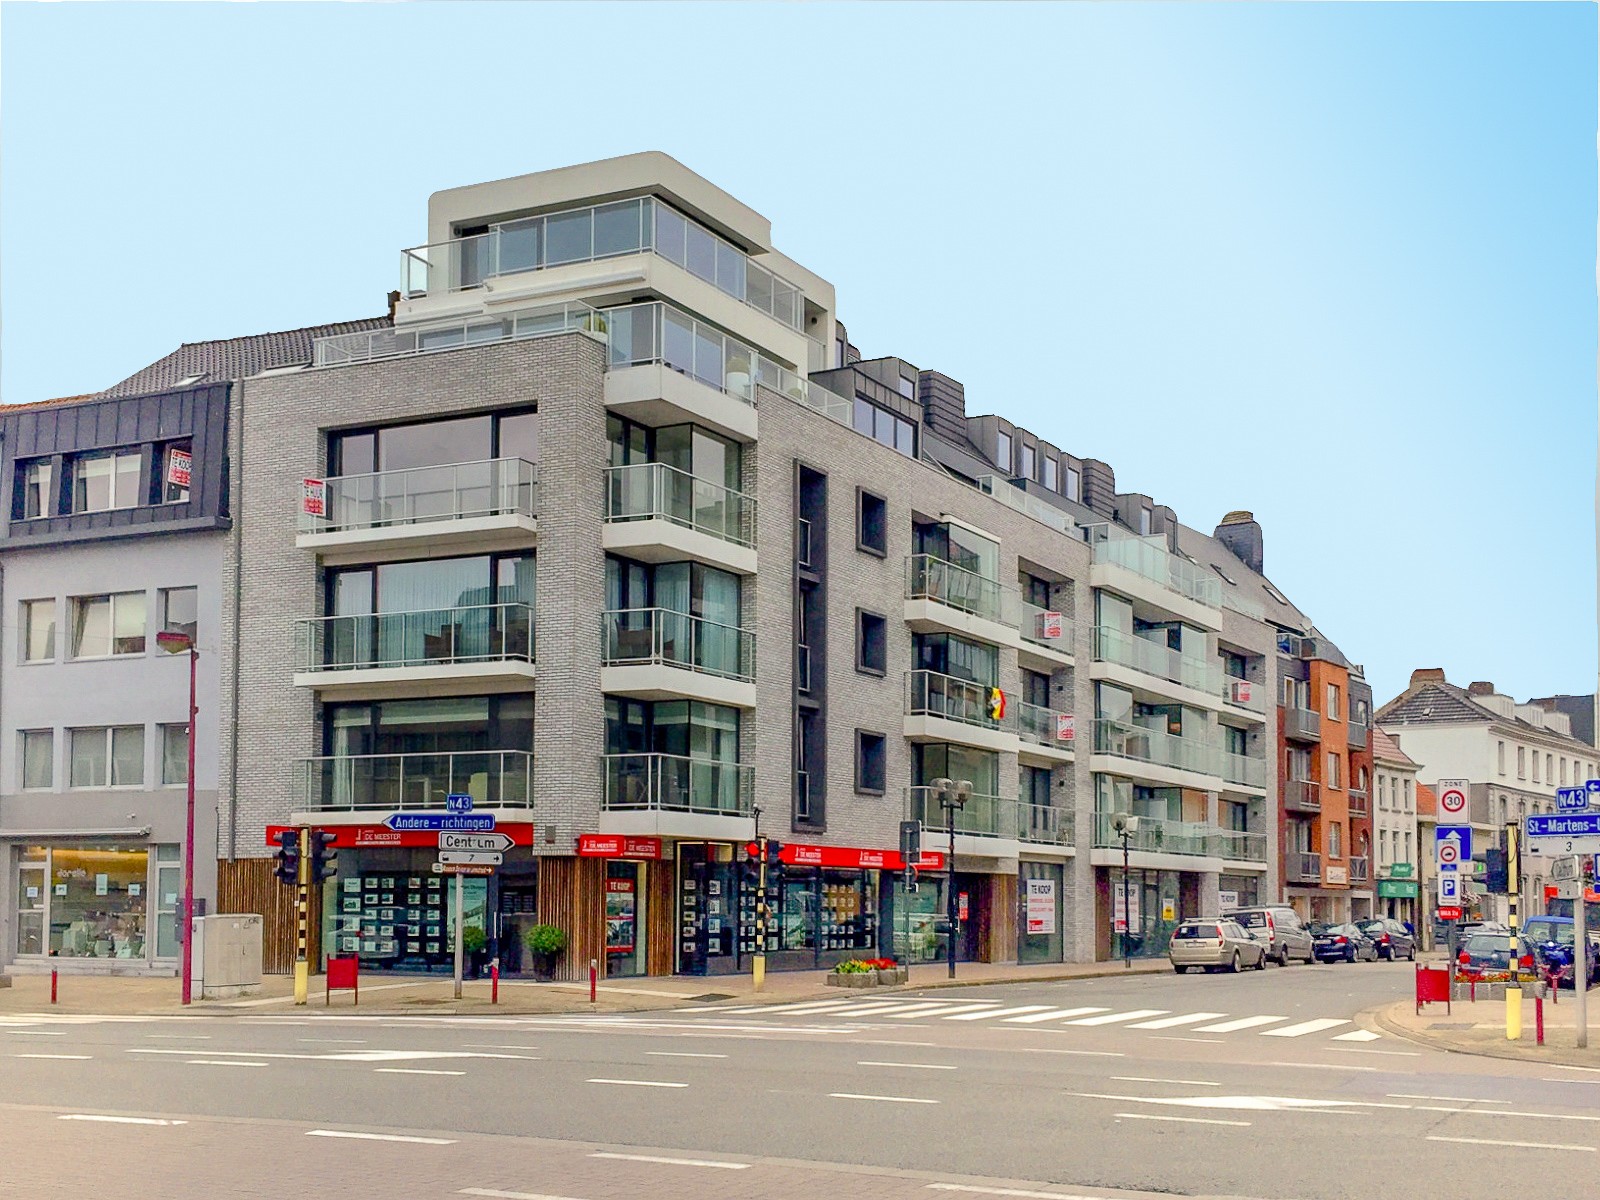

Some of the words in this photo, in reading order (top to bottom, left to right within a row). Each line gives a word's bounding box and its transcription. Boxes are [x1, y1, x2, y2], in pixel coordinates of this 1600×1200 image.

[449, 798, 471, 809] N43
[1447, 796, 1460, 806] 30
[1559, 790, 1585, 807] N43
[395, 816, 429, 829] Andere
[441, 816, 491, 831] richtingen
[1565, 842, 1572, 852] 3
[1444, 881, 1454, 895] P
